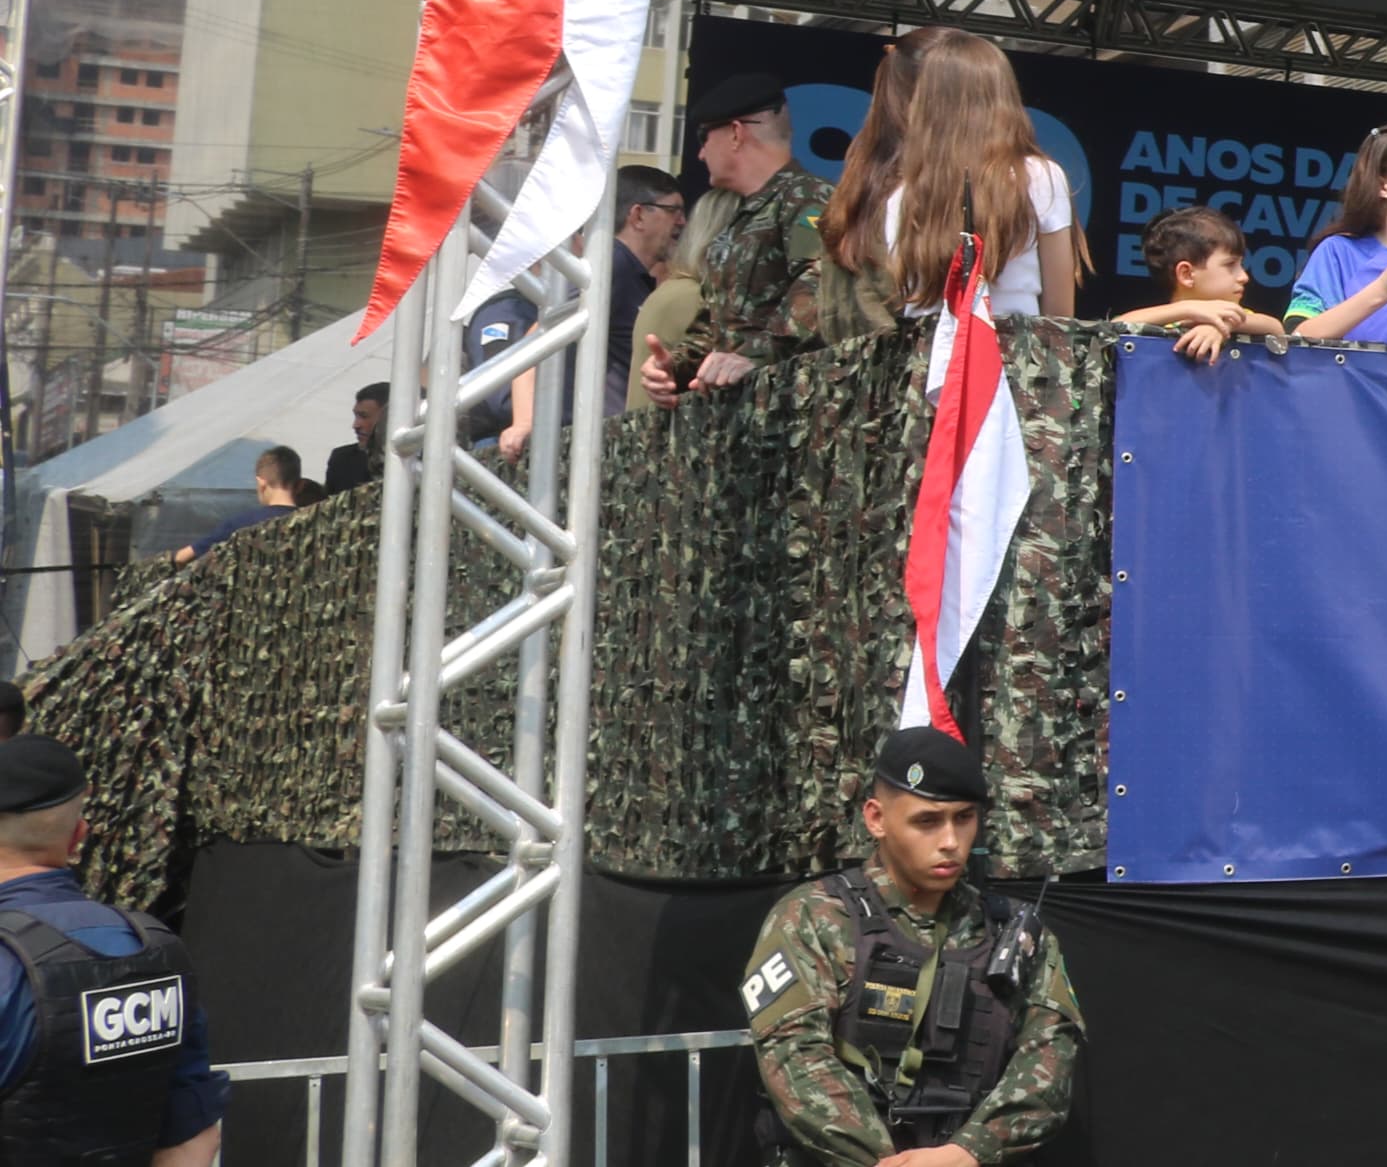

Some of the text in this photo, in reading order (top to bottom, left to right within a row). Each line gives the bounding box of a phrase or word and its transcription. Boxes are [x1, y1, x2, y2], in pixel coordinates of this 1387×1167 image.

[1120, 130, 1285, 185] ANOS
[742, 951, 793, 1013] PE
[94, 986, 177, 1041] GCM
[94, 1040, 127, 1053] PONTA
